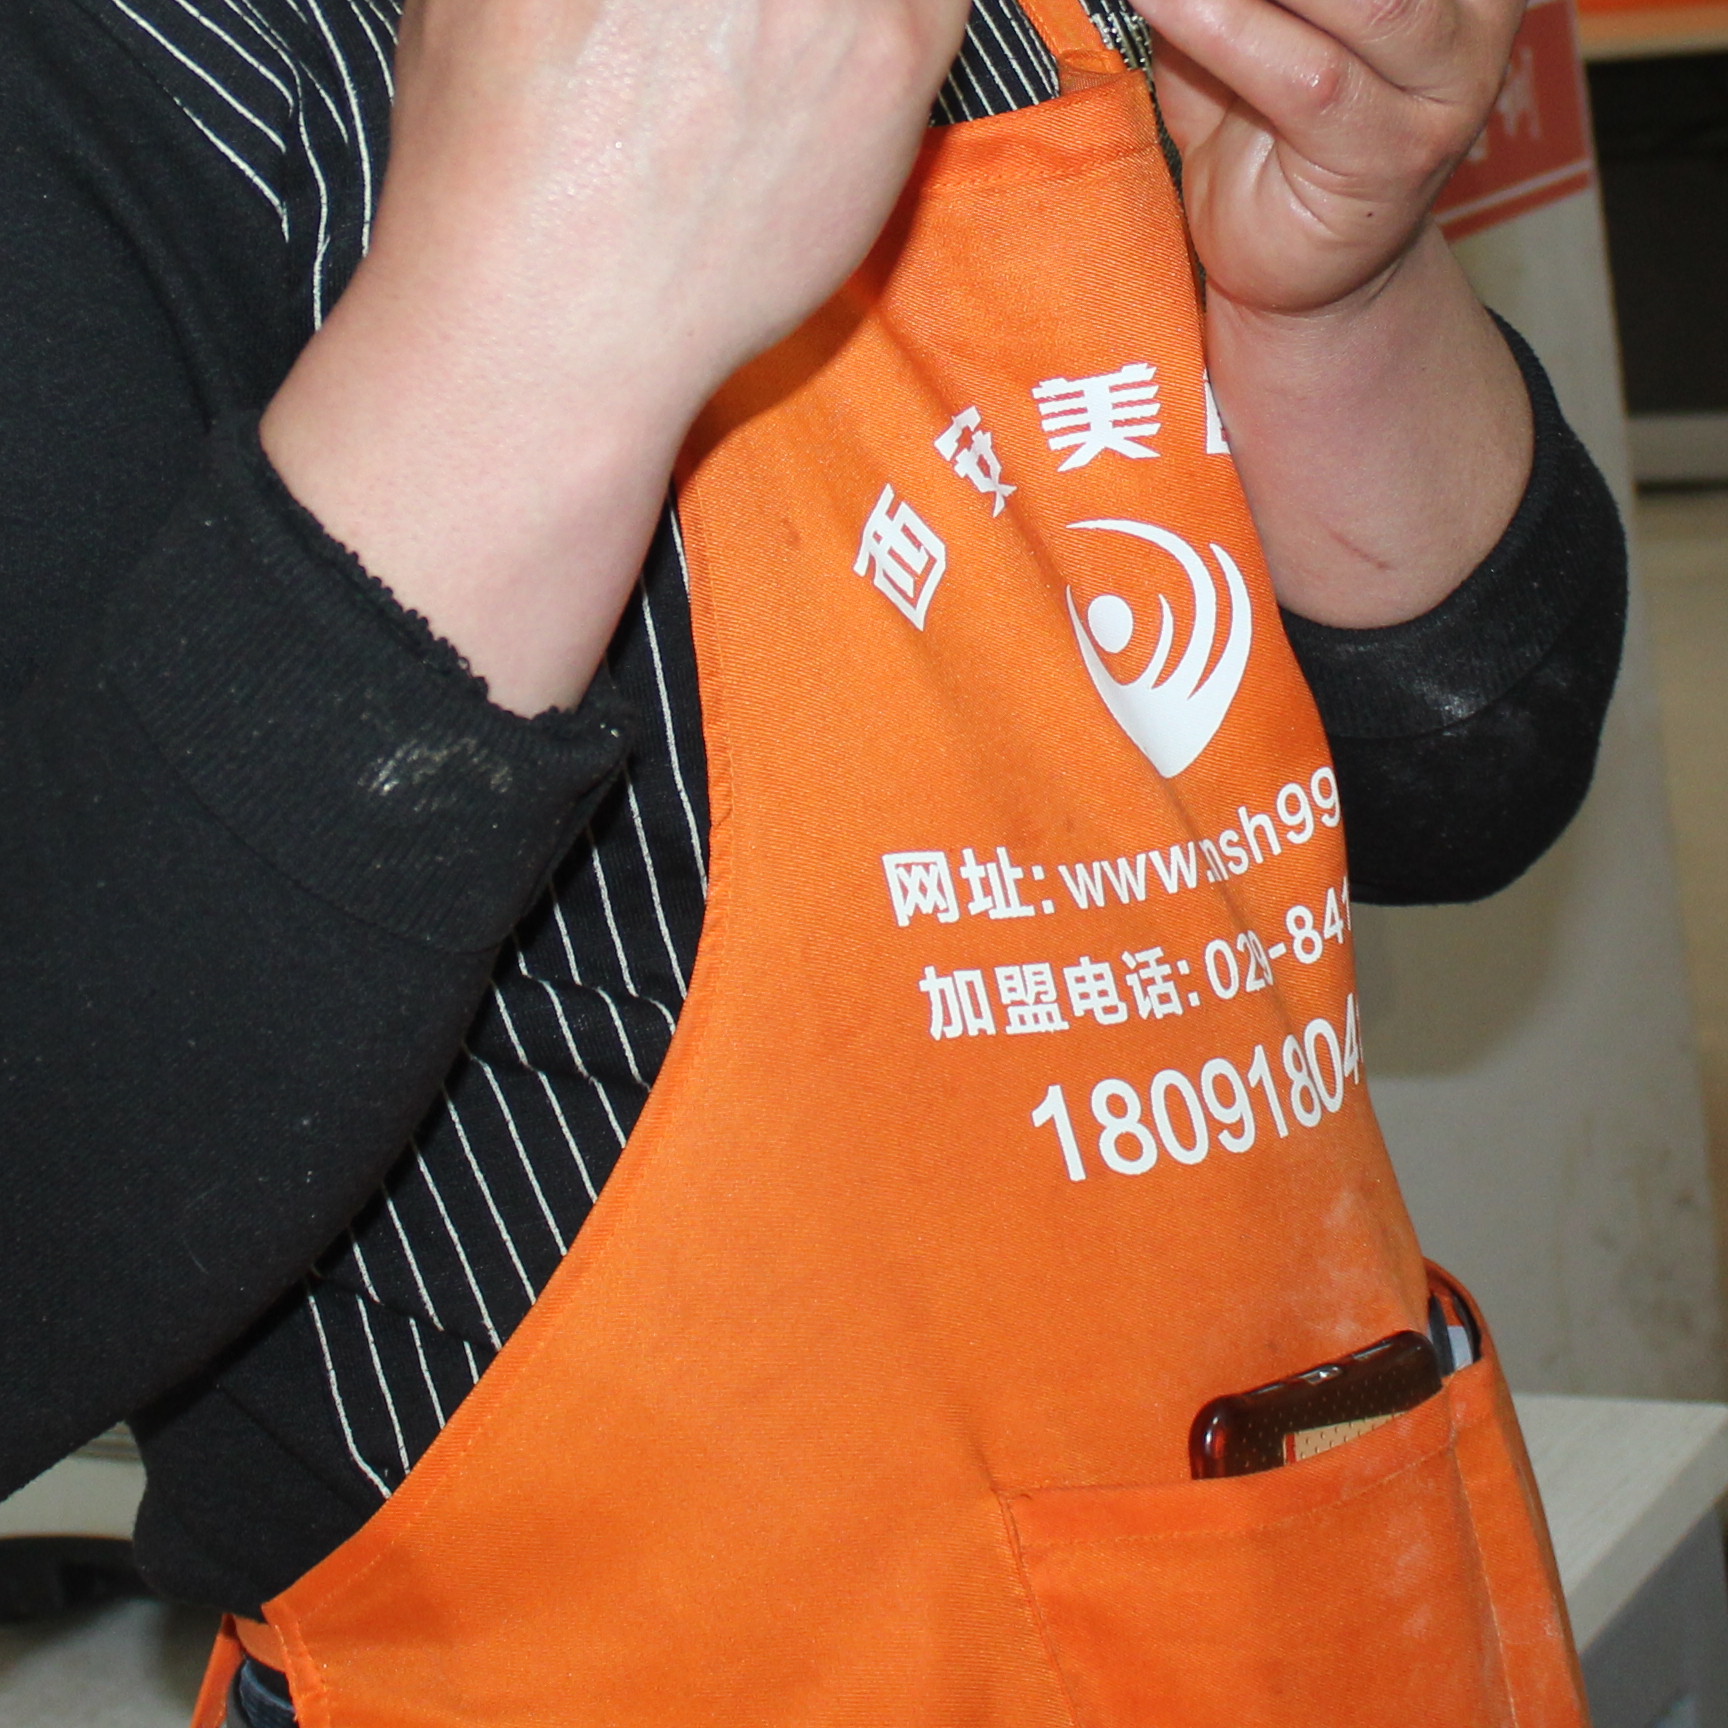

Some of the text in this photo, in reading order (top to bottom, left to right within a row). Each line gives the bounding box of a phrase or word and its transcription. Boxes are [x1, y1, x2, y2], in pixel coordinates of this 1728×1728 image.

[853, 362, 1230, 632] 西安美
[1032, 992, 1363, 1182] 18091804
